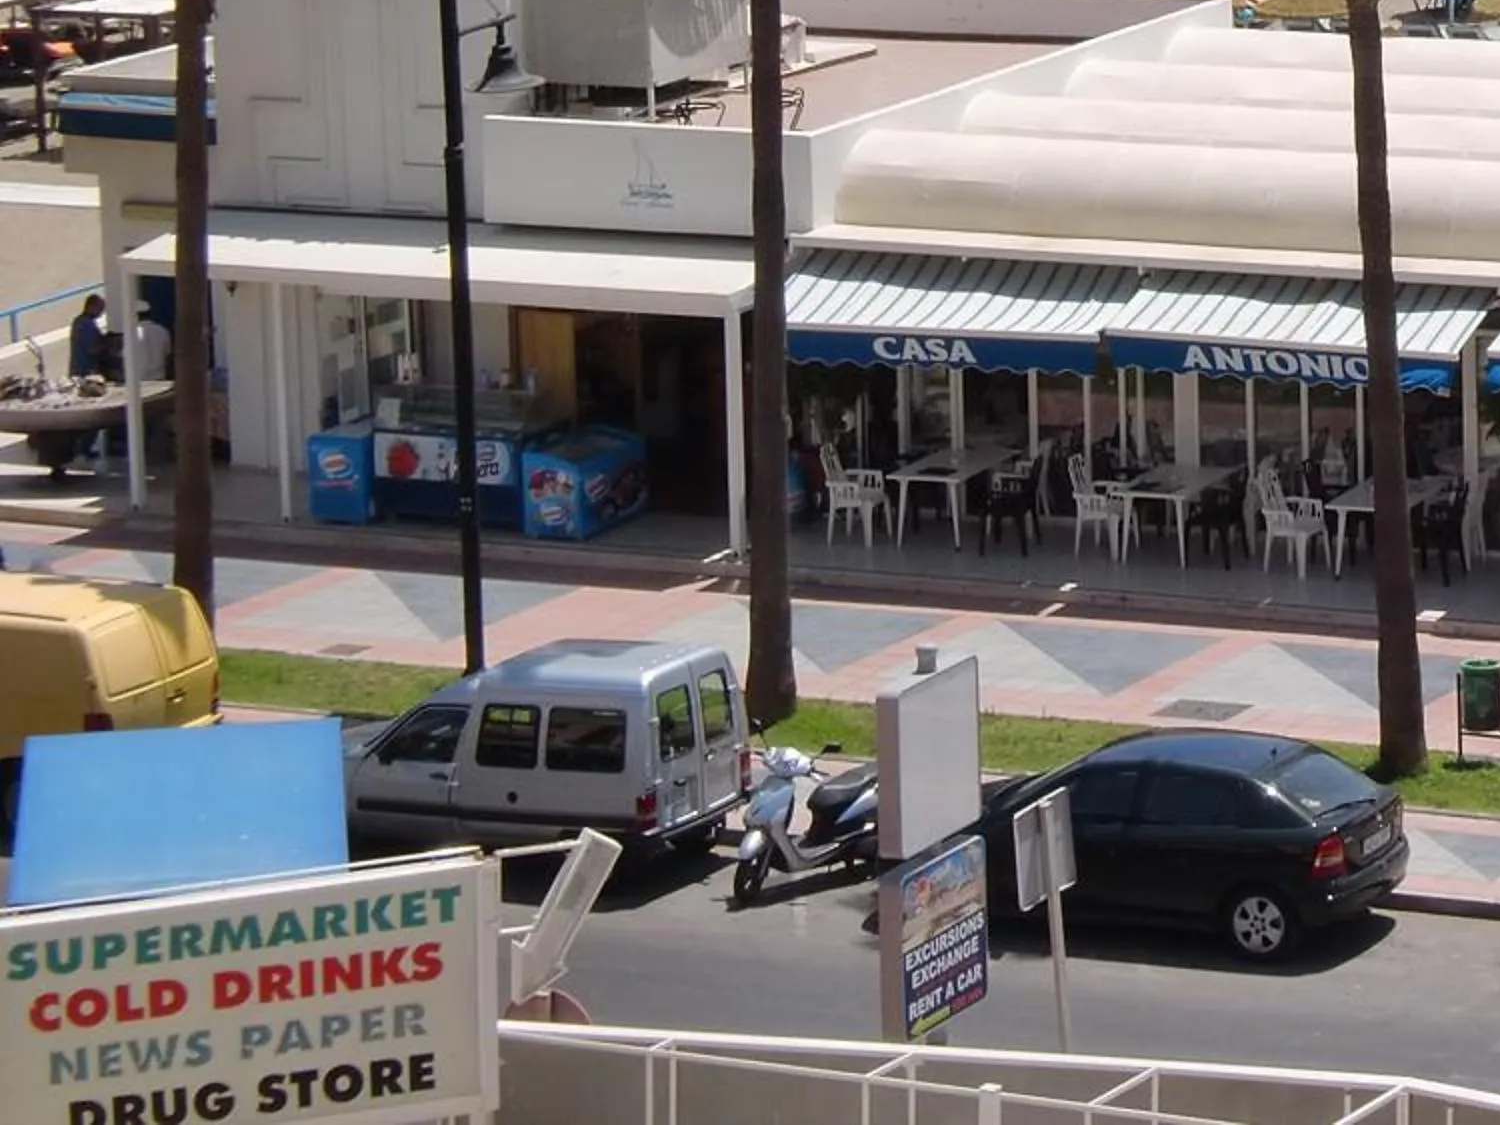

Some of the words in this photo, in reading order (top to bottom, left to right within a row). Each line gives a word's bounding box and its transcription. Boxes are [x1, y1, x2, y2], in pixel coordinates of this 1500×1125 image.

[873, 336, 977, 364] CASA
[1183, 344, 1369, 380] ANTONIO
[7, 885, 462, 981] SUPERMARKET
[904, 911, 985, 972] EXCURSIONS
[911, 935, 979, 990] EXCHANGE
[29, 979, 188, 1033] COLD
[213, 942, 444, 1011] DRINKS
[908, 986, 943, 1022] RENT
[945, 980, 955, 1001] A
[957, 962, 983, 992] CAR
[49, 1030, 213, 1086] NEWS
[240, 1002, 428, 1060] PAPER
[69, 1082, 235, 1125] DRUG
[257, 1053, 436, 1114] STORE
